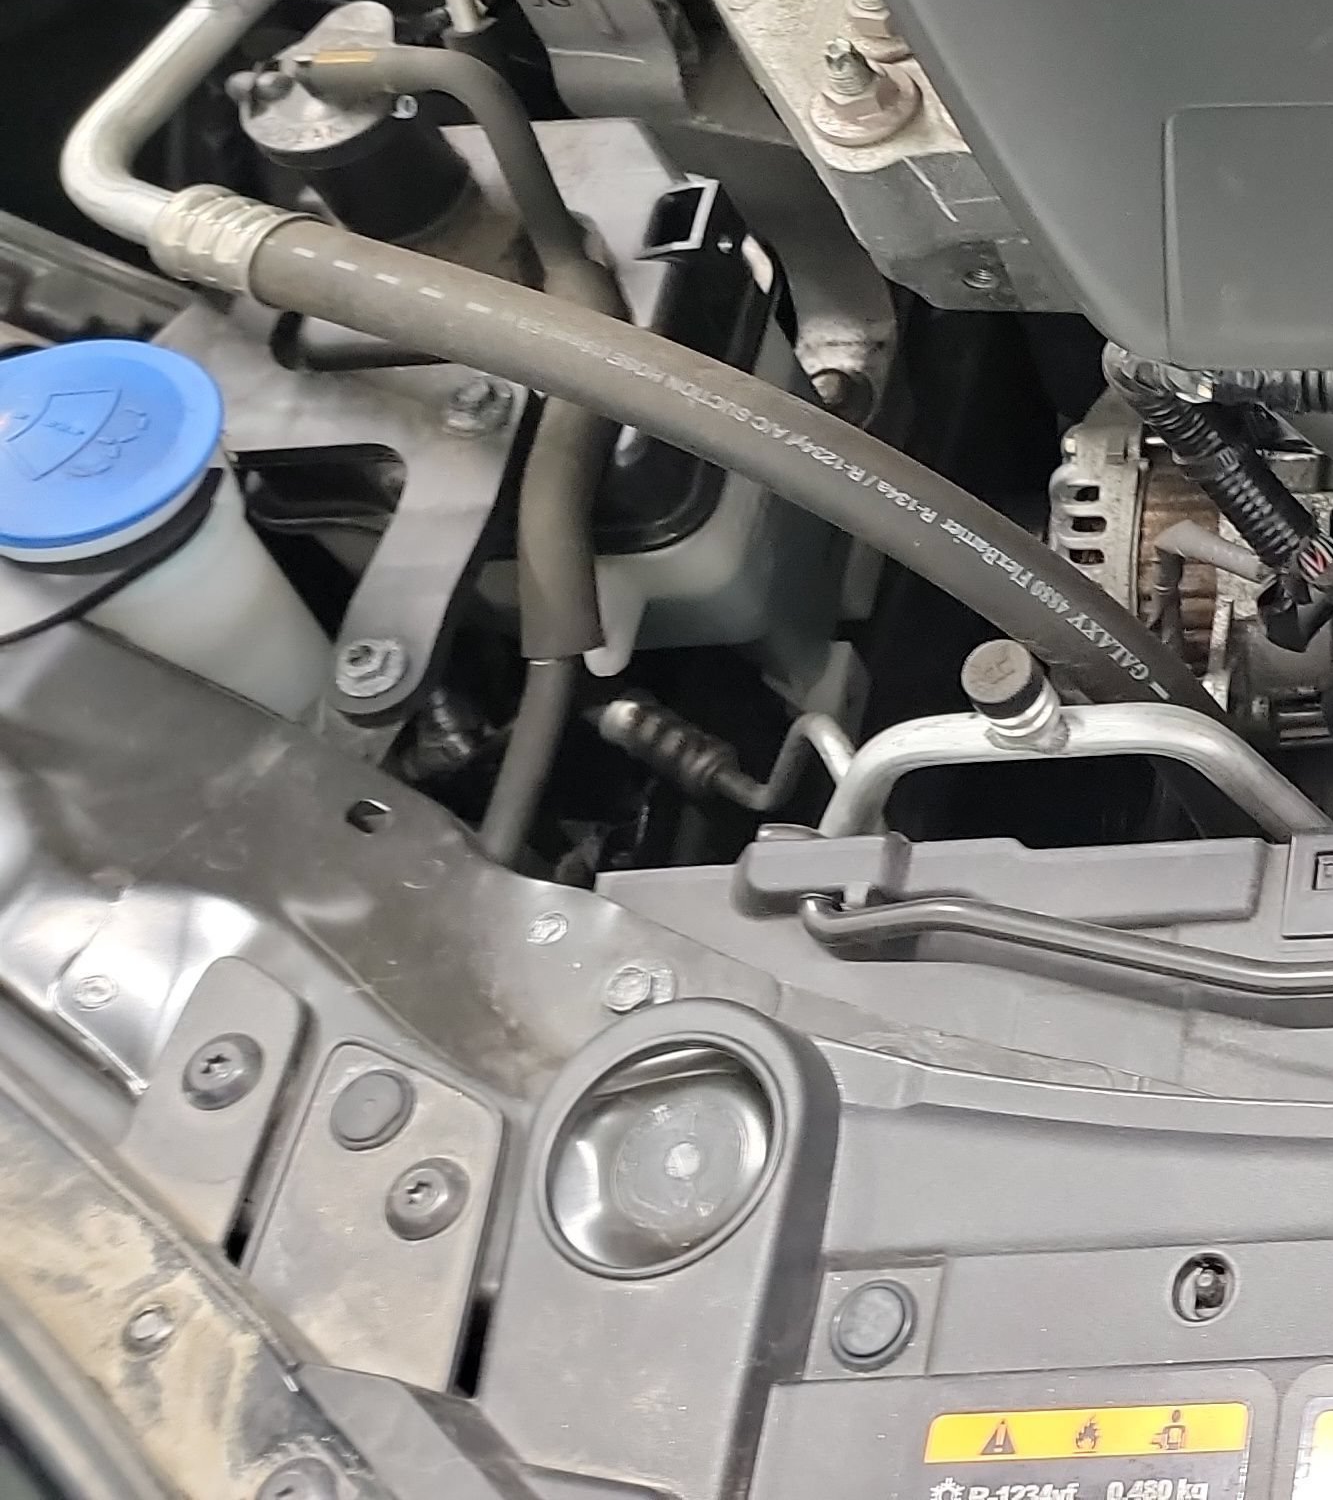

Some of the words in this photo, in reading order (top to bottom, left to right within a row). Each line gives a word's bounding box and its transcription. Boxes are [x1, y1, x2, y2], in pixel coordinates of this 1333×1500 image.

[876, 479, 938, 525] R-134a
[939, 517, 1035, 589] FlexBarrier
[1066, 611, 1150, 681] GALAXY
